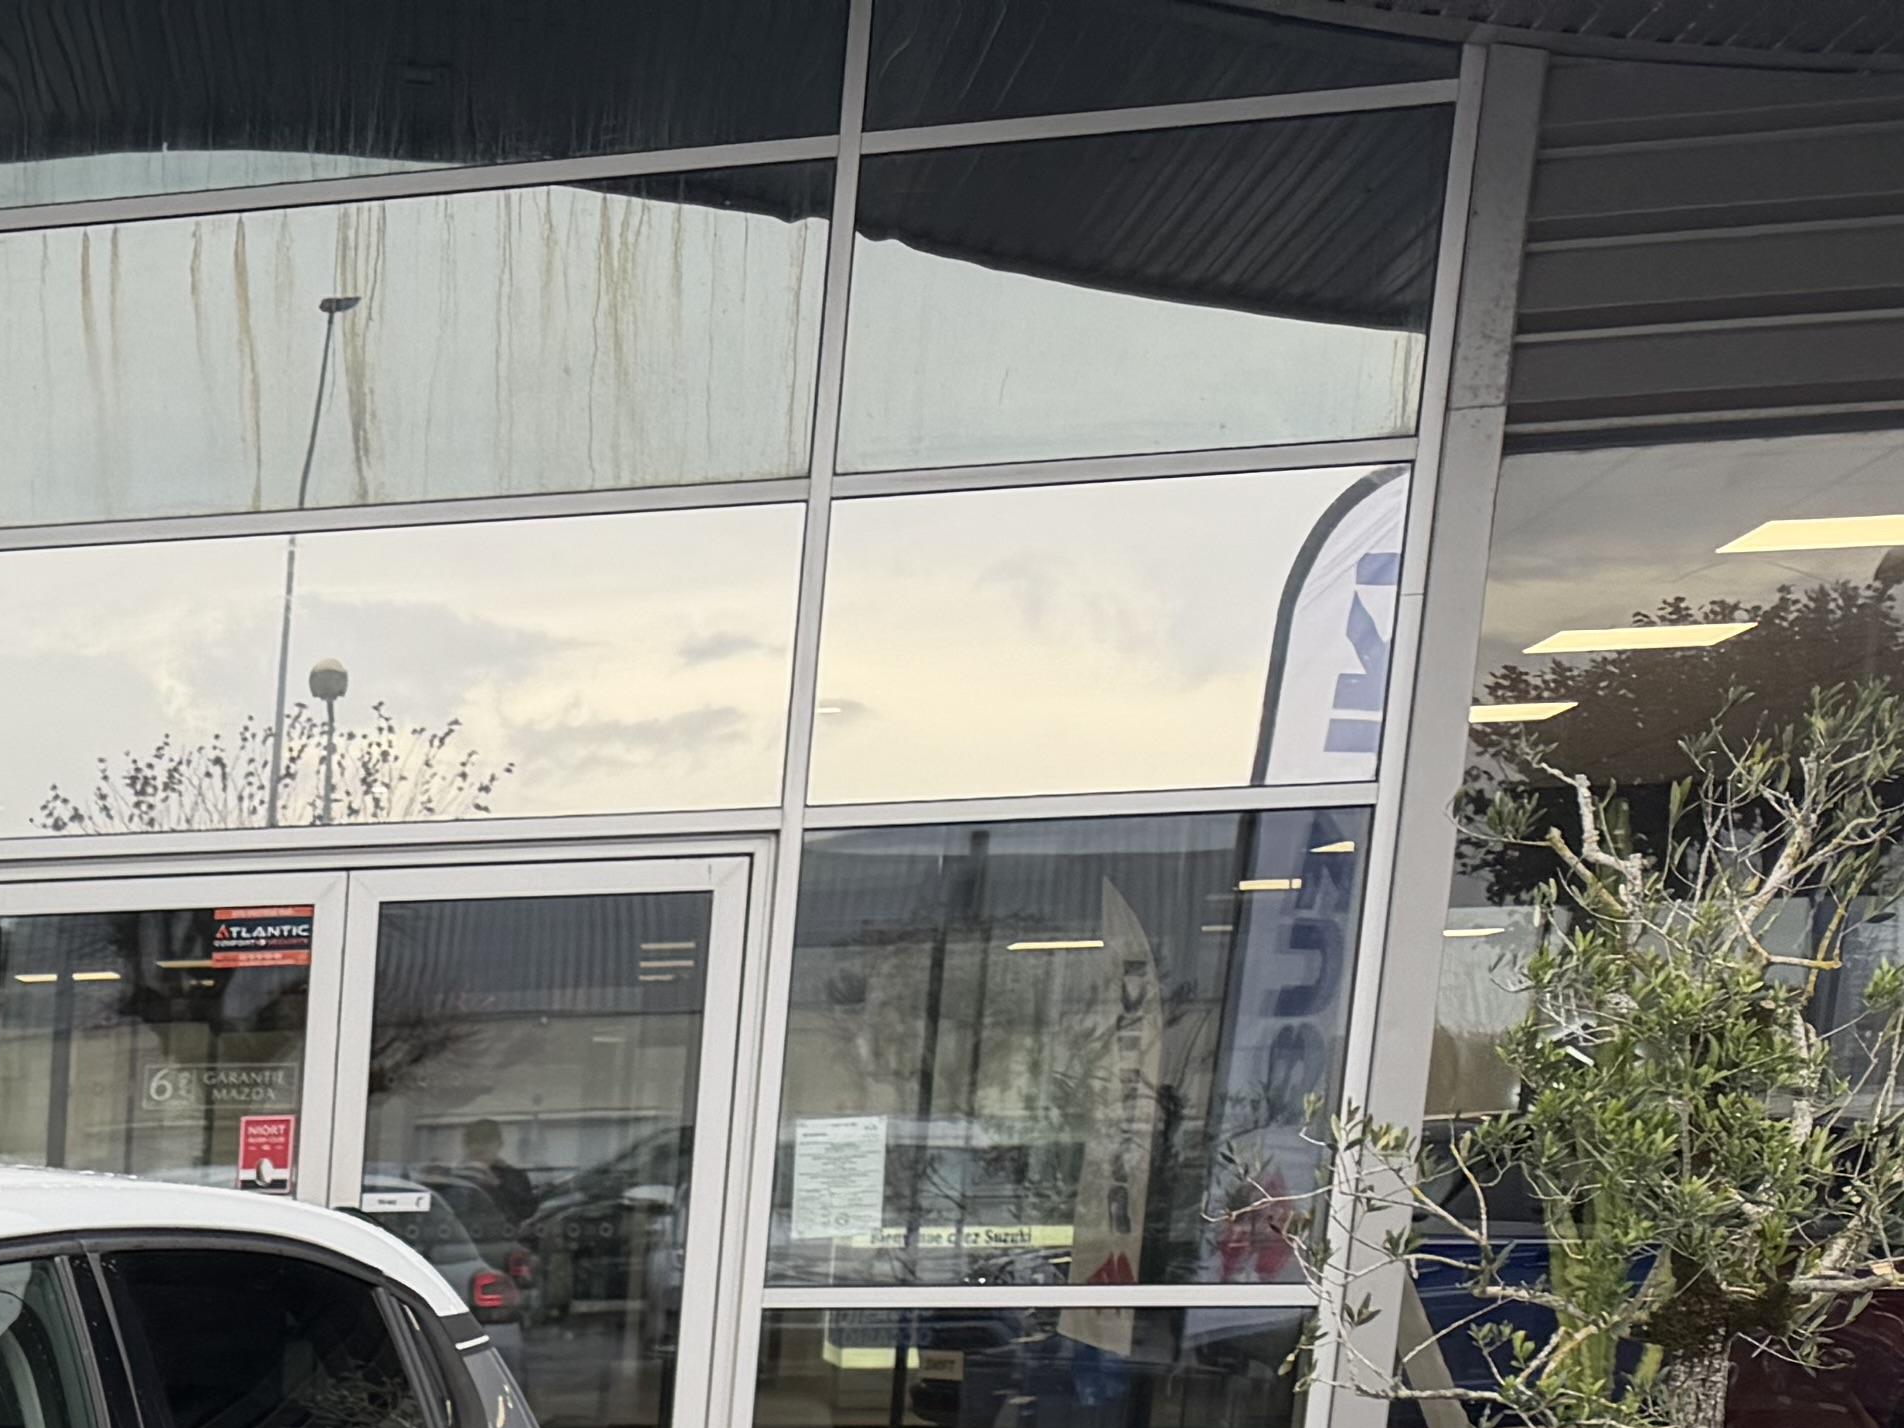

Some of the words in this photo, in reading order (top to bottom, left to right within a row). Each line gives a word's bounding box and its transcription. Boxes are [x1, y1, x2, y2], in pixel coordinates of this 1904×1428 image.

[215, 924, 310, 938] ATLANTIC
[149, 1067, 173, 1102] 6
[203, 1069, 287, 1086] GARANTIE
[211, 1086, 276, 1102] MAZDA
